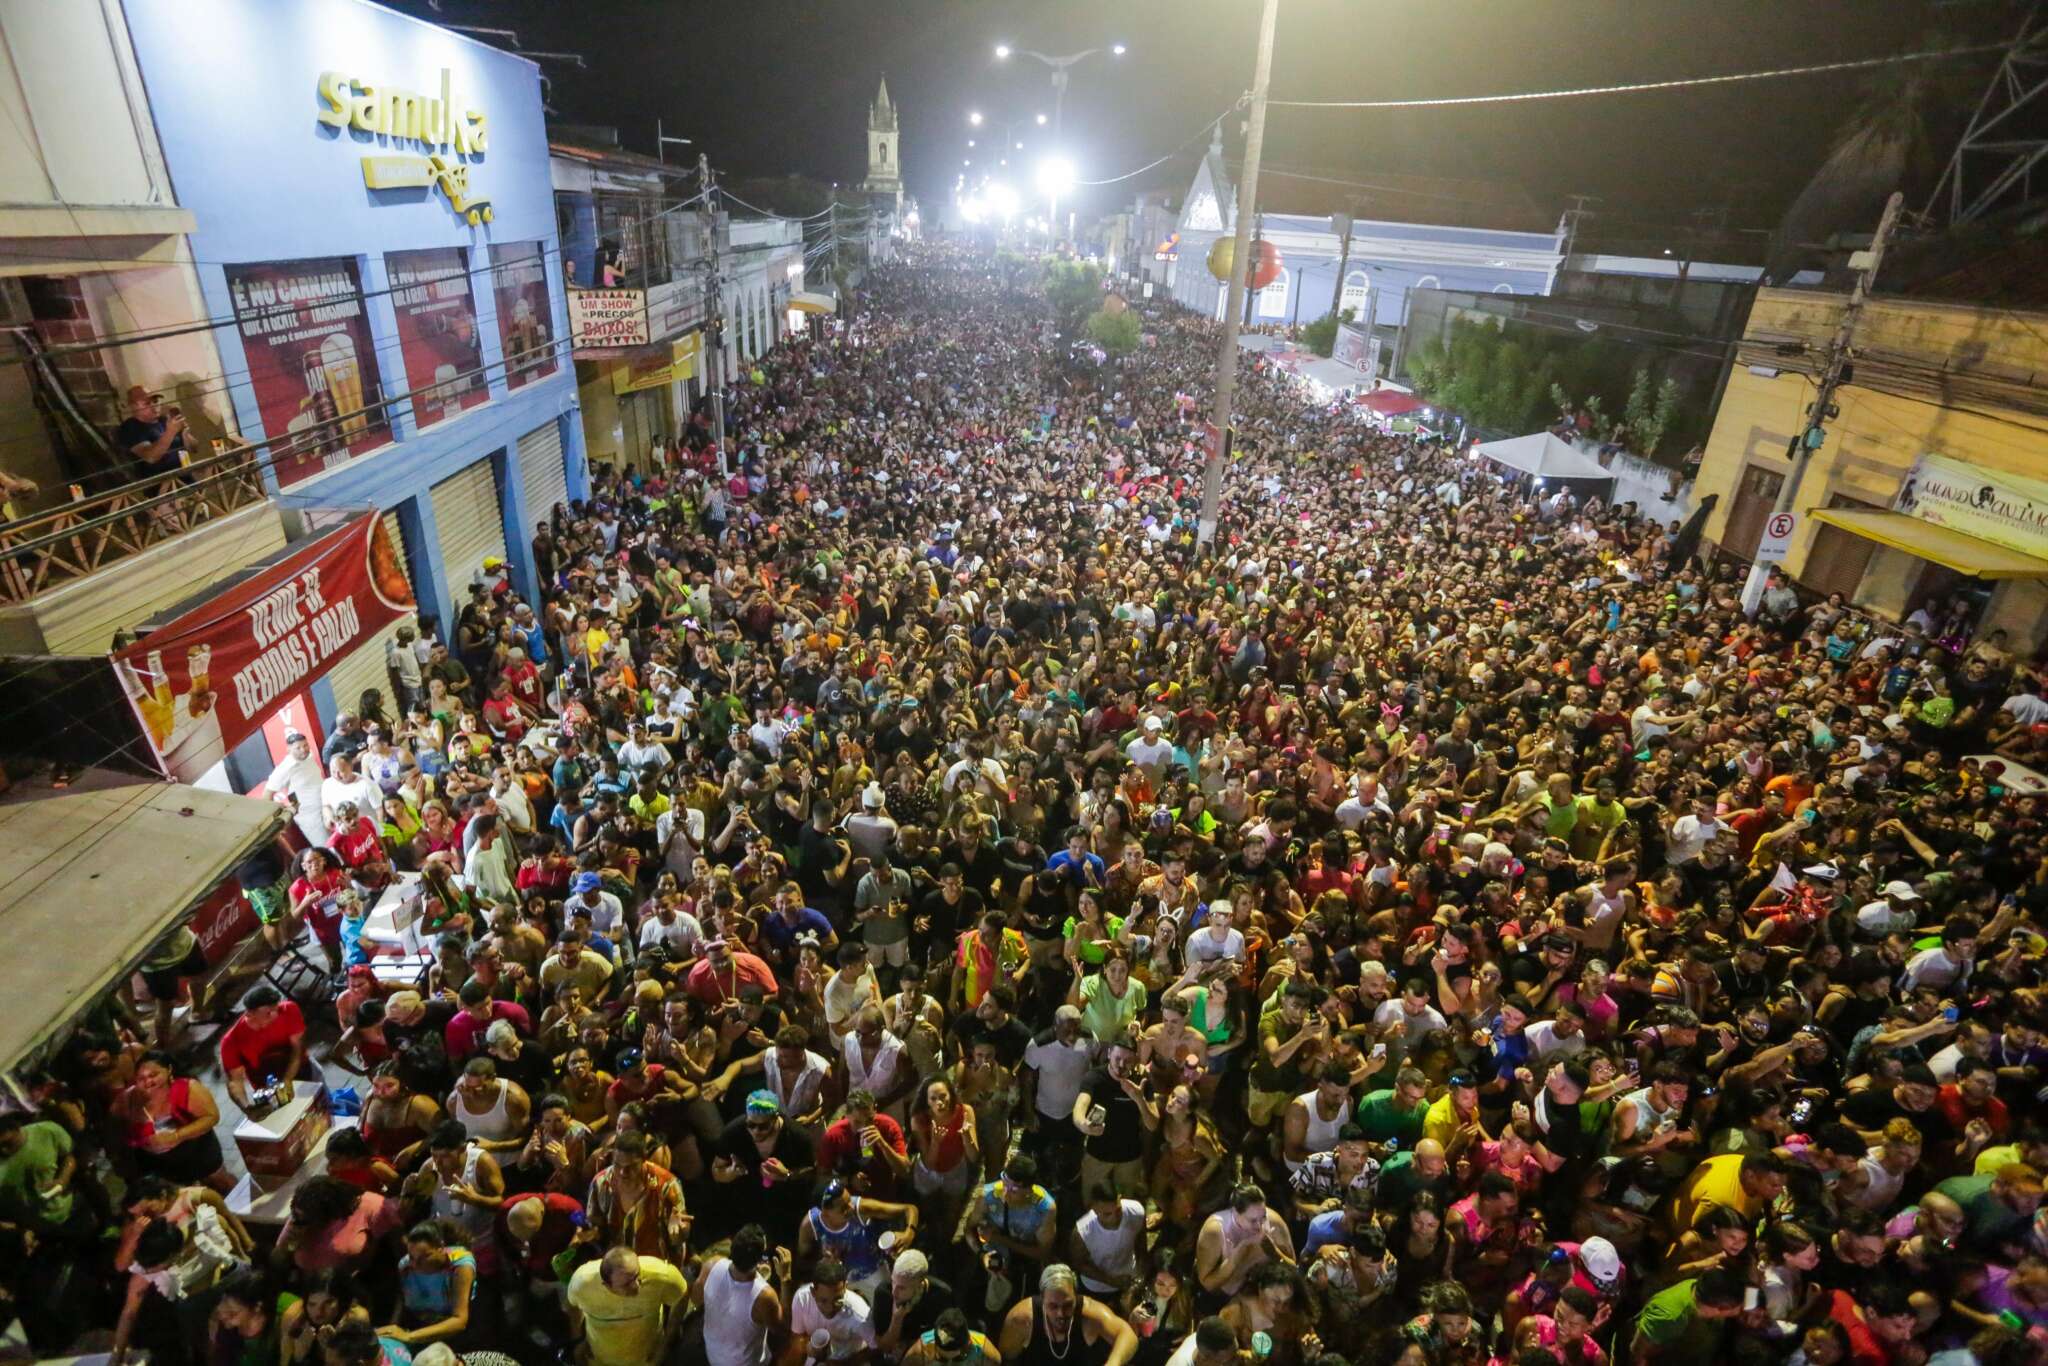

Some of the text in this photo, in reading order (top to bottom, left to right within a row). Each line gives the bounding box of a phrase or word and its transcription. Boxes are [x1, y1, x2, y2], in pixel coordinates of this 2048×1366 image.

[248, 280, 276, 307] NO
[277, 272, 356, 303] CARNAVAL
[581, 299, 633, 310] UM SHOW
[246, 567, 326, 649] VENDE-SE
[233, 595, 360, 720] BEBIDAS E CALDO
